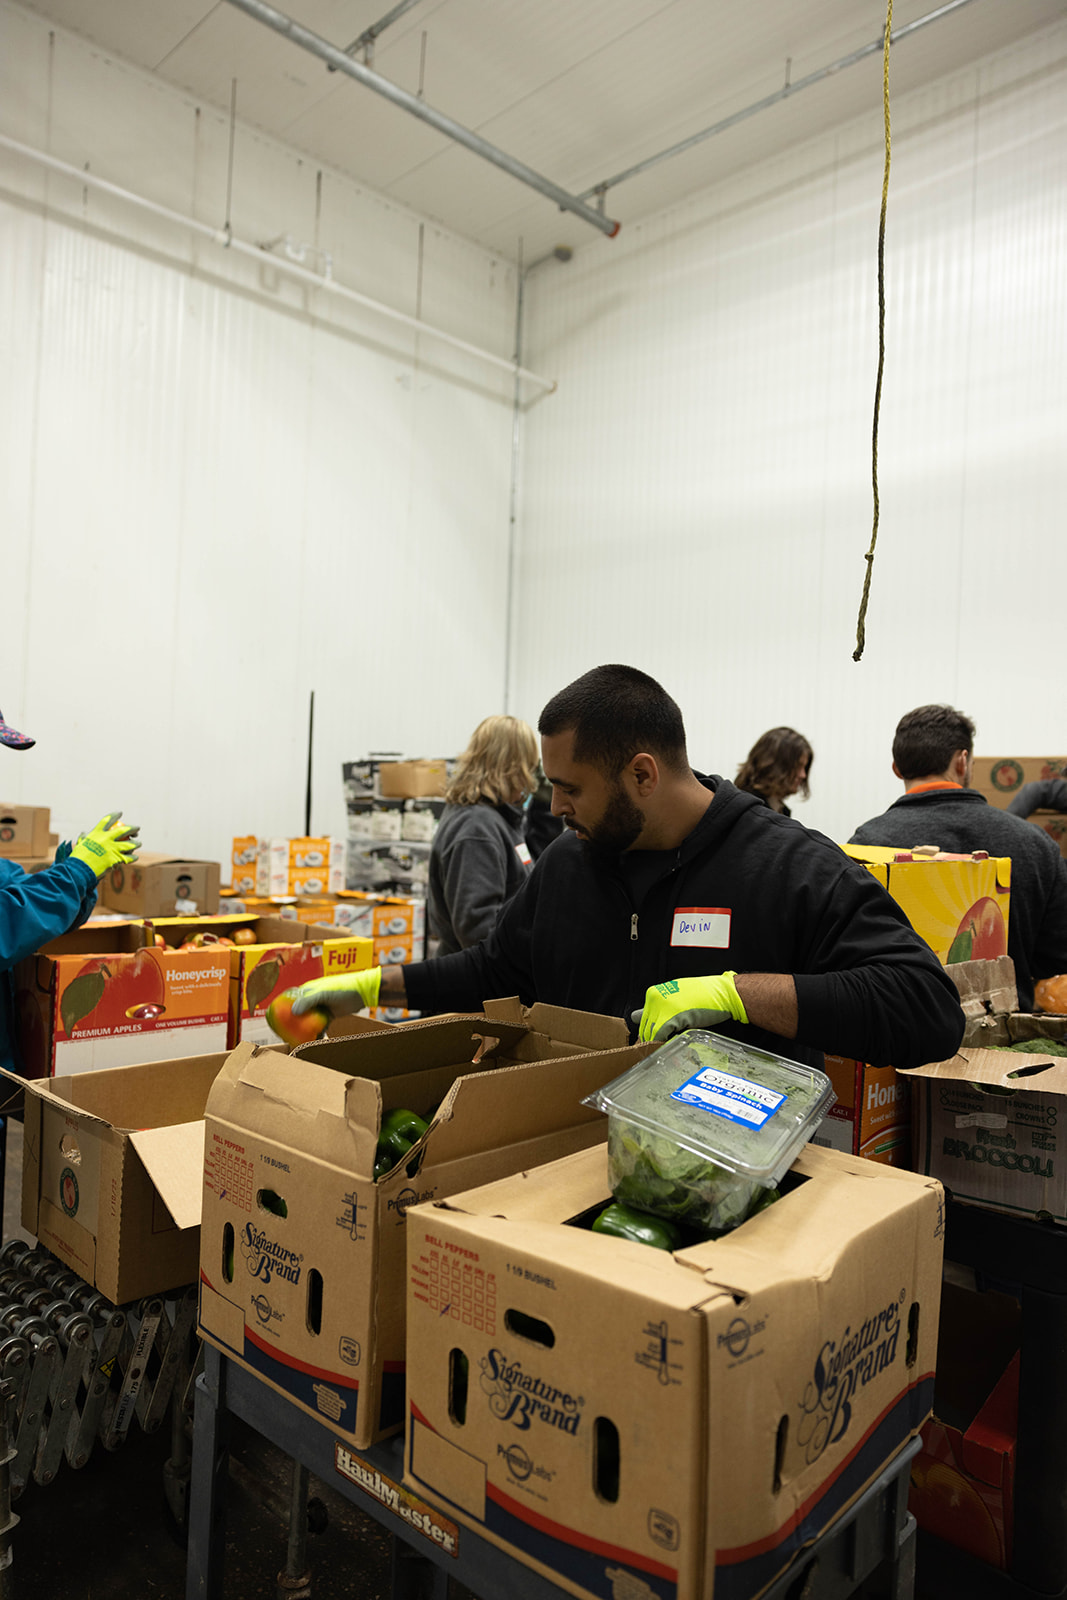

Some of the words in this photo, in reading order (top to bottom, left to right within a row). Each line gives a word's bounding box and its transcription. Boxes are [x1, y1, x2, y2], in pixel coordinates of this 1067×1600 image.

[328, 948, 357, 969] Fuji
[166, 966, 226, 983] Honeycrisp
[71, 1027, 111, 1039] PREMIUM
[113, 1023, 142, 1034] APPLES
[164, 1019, 187, 1028] VOLUME
[700, 1082, 724, 1094] Baby
[725, 1091, 763, 1110] Spinach
[704, 1074, 774, 1104] Organic
[1013, 1101, 1045, 1113] BUNCHES
[224, 1139, 245, 1154] PEPPERS
[943, 1136, 1054, 1178] BROCCOLI
[271, 1158, 291, 1174] BUSHEL
[425, 1233, 443, 1249] BELL
[444, 1241, 480, 1262] PEPPERS
[247, 1251, 301, 1285] Brand
[506, 1263, 510, 1273] 1
[524, 1269, 557, 1291] BUSHEL
[130, 1381, 139, 1394] 175
[798, 1318, 901, 1465] Brand
[488, 1388, 581, 1436] Brand
[336, 1445, 456, 1552] HaulMaster
